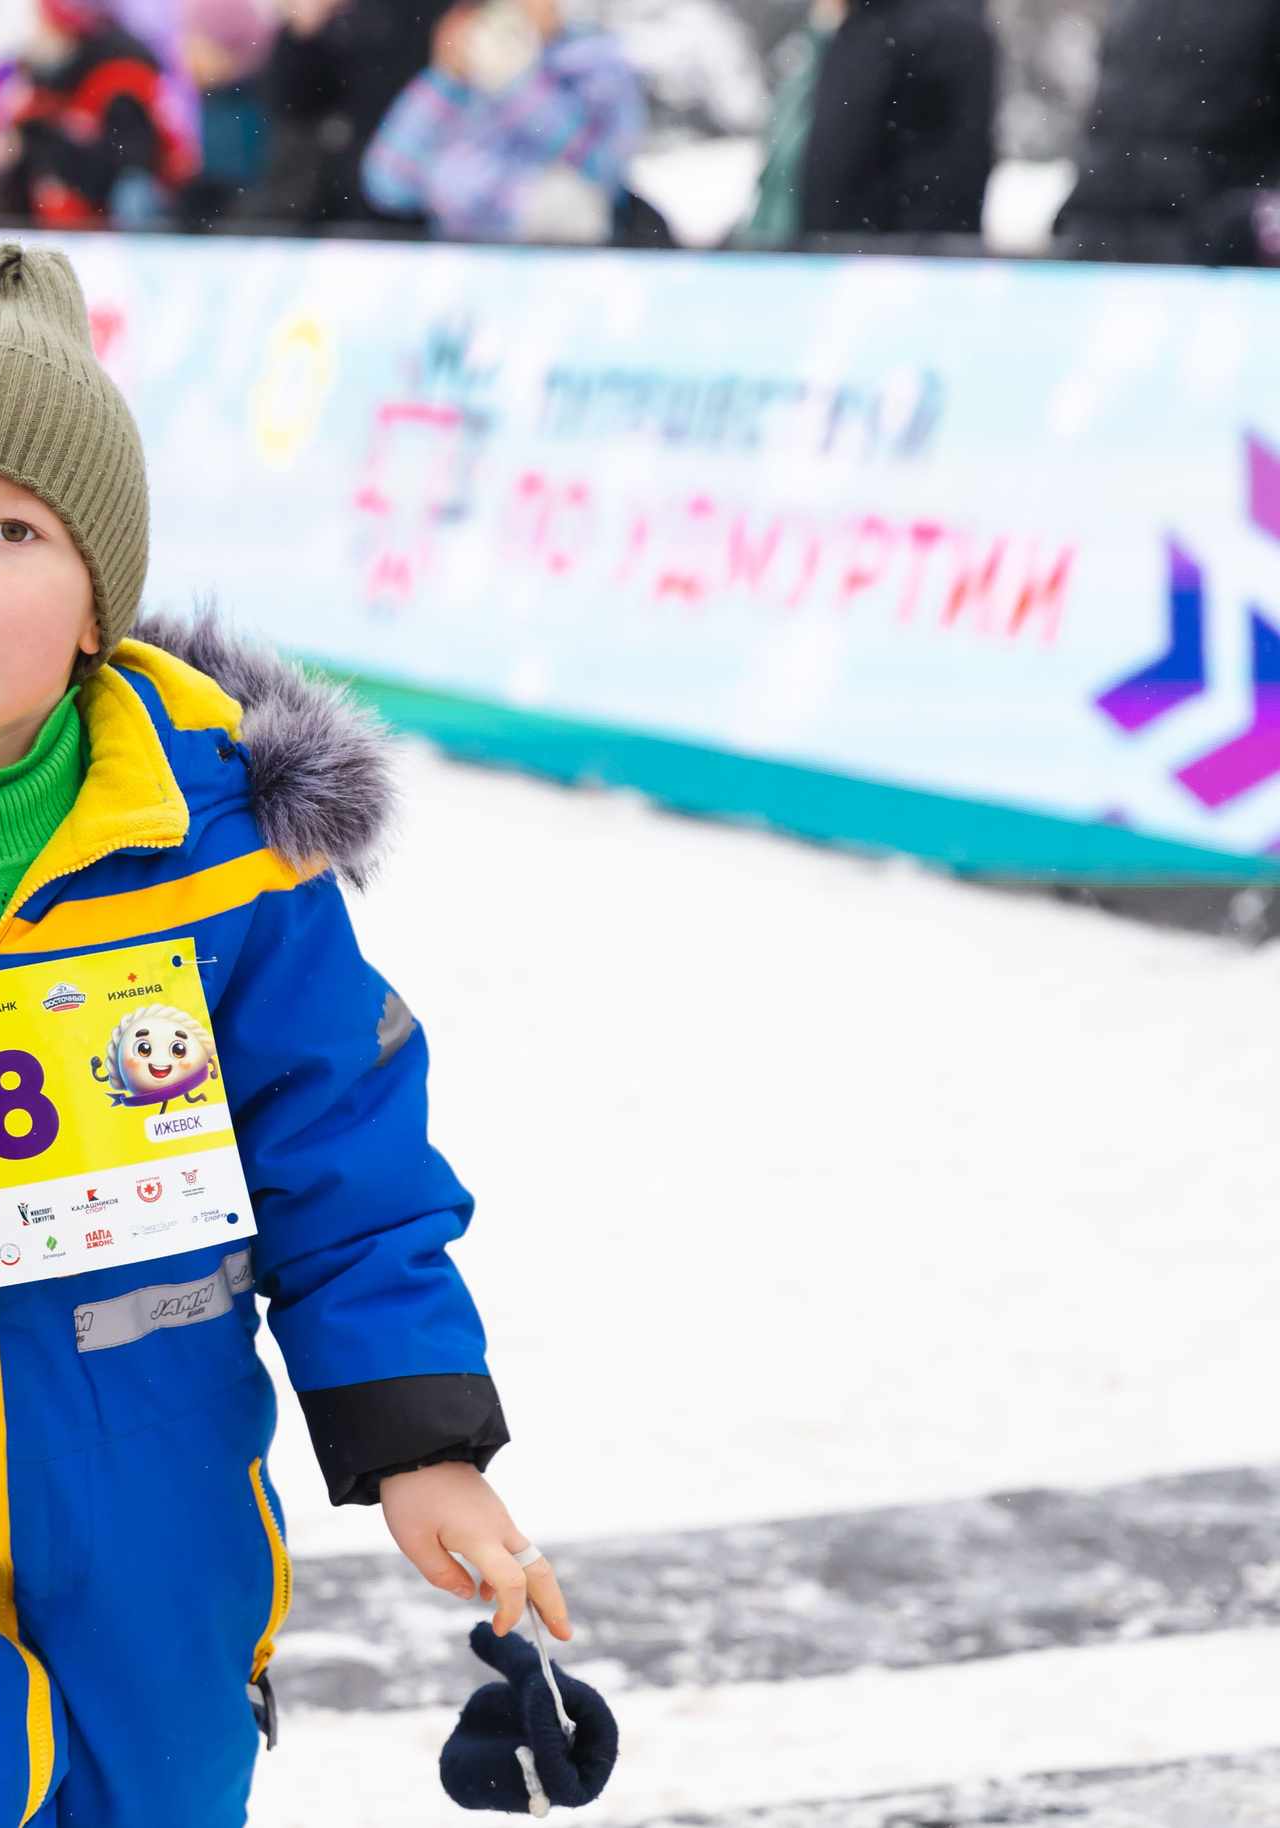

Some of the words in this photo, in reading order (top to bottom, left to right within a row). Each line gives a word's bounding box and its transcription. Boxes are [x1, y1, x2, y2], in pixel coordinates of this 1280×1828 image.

[107, 983, 163, 1001] ижавиа
[44, 994, 85, 1010] ВОСТОЧНЫЙ
[153, 1115, 203, 1136] ИЖЕВСК
[70, 1198, 119, 1212] КАЛАШНИКОВ
[84, 1206, 107, 1215] СПОРТ
[200, 1209, 220, 1218] ТОЧКА
[204, 1213, 228, 1223] СПОРТА
[85, 1229, 112, 1243] ПАПА
[86, 1238, 115, 1249] ДЖОНС
[150, 1283, 214, 1320] JAMM
